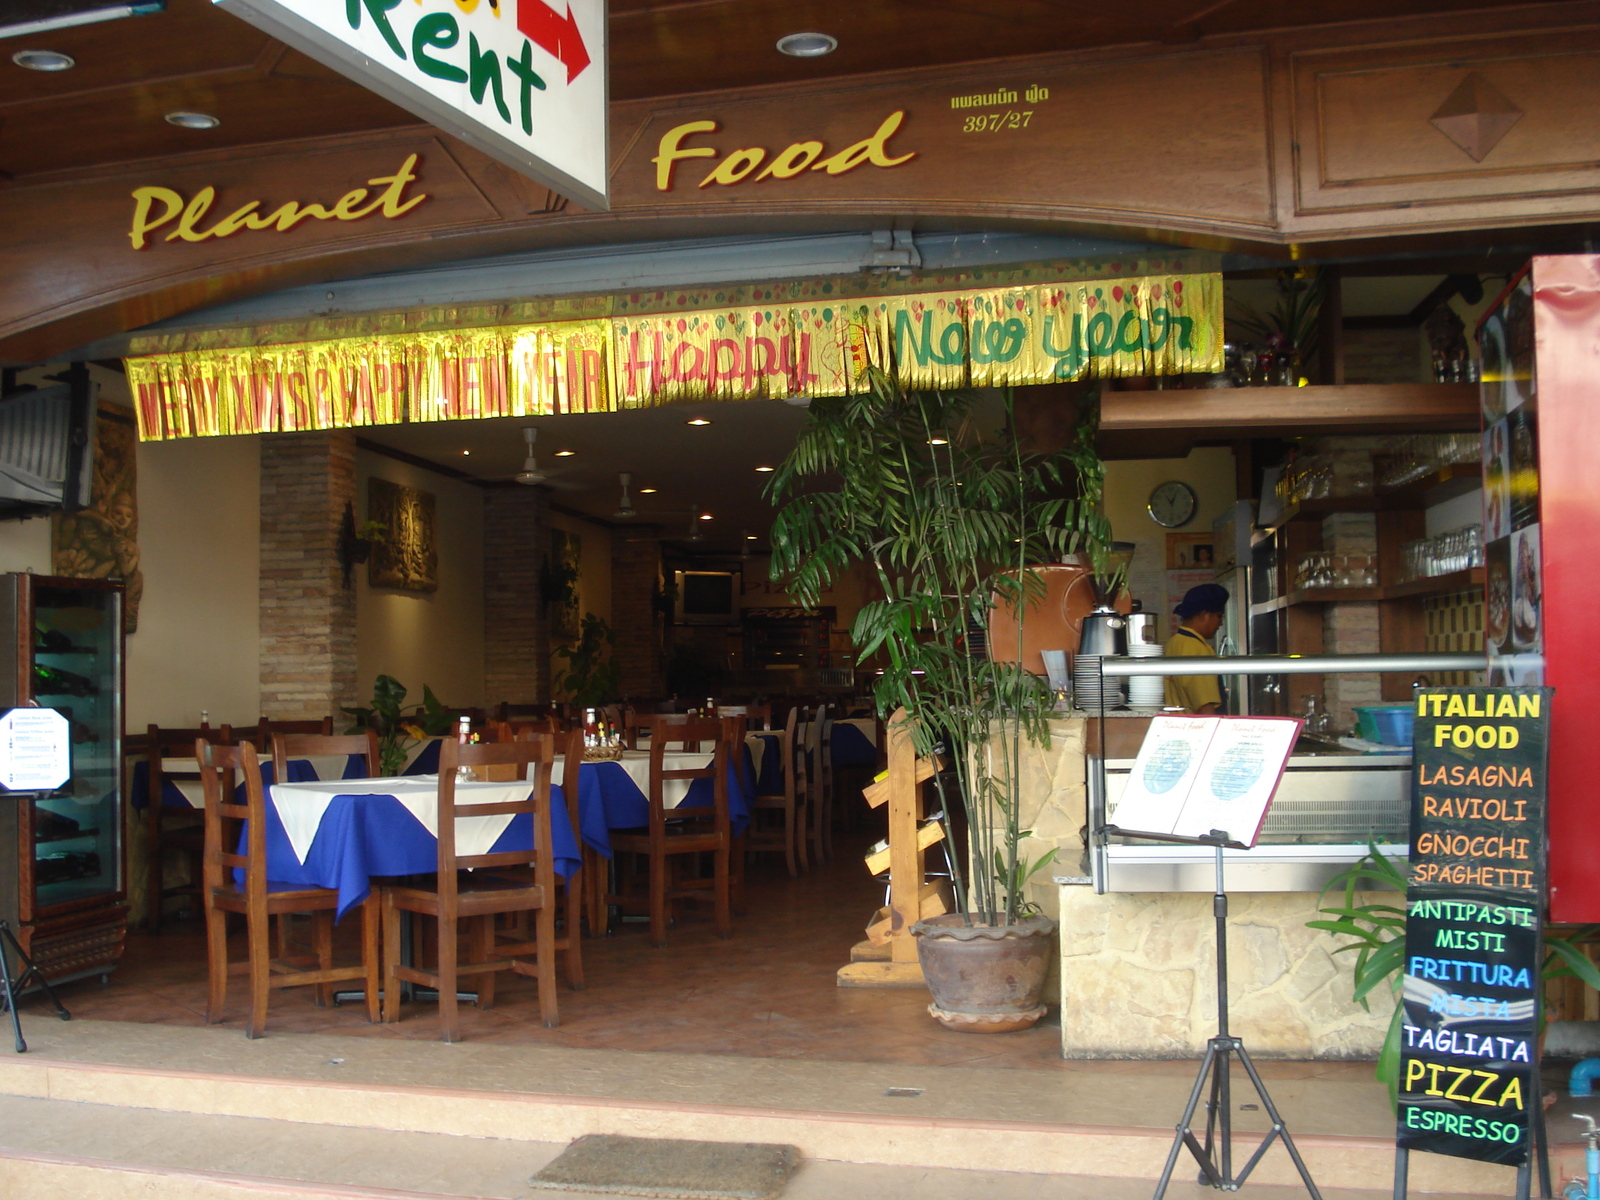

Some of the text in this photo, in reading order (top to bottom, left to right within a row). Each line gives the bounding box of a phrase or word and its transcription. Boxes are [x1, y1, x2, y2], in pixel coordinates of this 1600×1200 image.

[963, 110, 1034, 132] 397/27
[129, 110, 916, 249] Planet Food
[622, 331, 818, 396] Happy
[895, 308, 1030, 368] New
[315, 368, 331, 424] &
[339, 359, 425, 424] HAPPY
[442, 354, 507, 416] NEW
[523, 349, 601, 411] YEAR
[740, 581, 834, 595] Piza
[1418, 694, 1541, 718] ITALIAN
[1434, 724, 1520, 750] FOOD
[1419, 764, 1534, 788] LASAGNA
[1423, 796, 1527, 822] RAVIOLI
[1417, 833, 1530, 859] GNOCCHI
[1414, 864, 1533, 888] SPAGHETTI
[1409, 900, 1533, 927] ANTIPASTI
[1435, 929, 1506, 952] MISTI
[1409, 956, 1531, 989] FRITTURA
[1428, 992, 1511, 1021] MISTA
[1403, 1025, 1529, 1062] TAGLIATA
[1405, 1059, 1524, 1110] PIZZA
[1406, 1107, 1520, 1144] ESPRESSO
